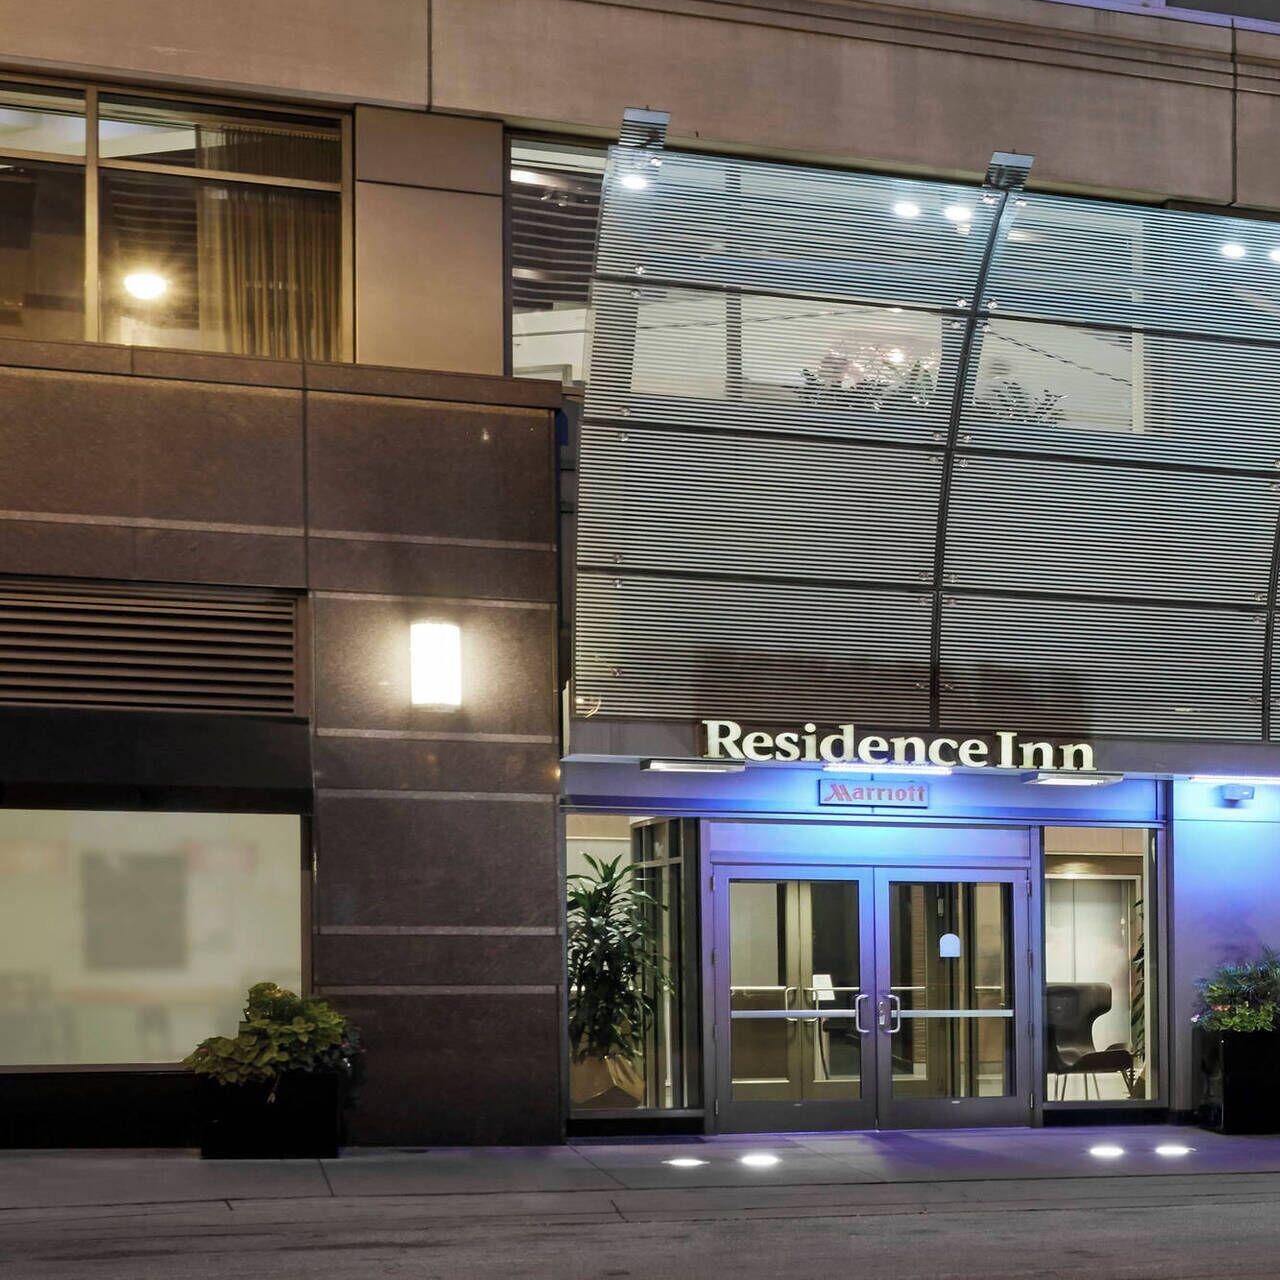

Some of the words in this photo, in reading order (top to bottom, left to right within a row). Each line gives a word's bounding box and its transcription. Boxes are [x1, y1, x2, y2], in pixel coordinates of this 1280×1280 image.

[701, 719, 988, 769] Residence
[996, 731, 1097, 772] Inn
[823, 782, 926, 803] Marriott
